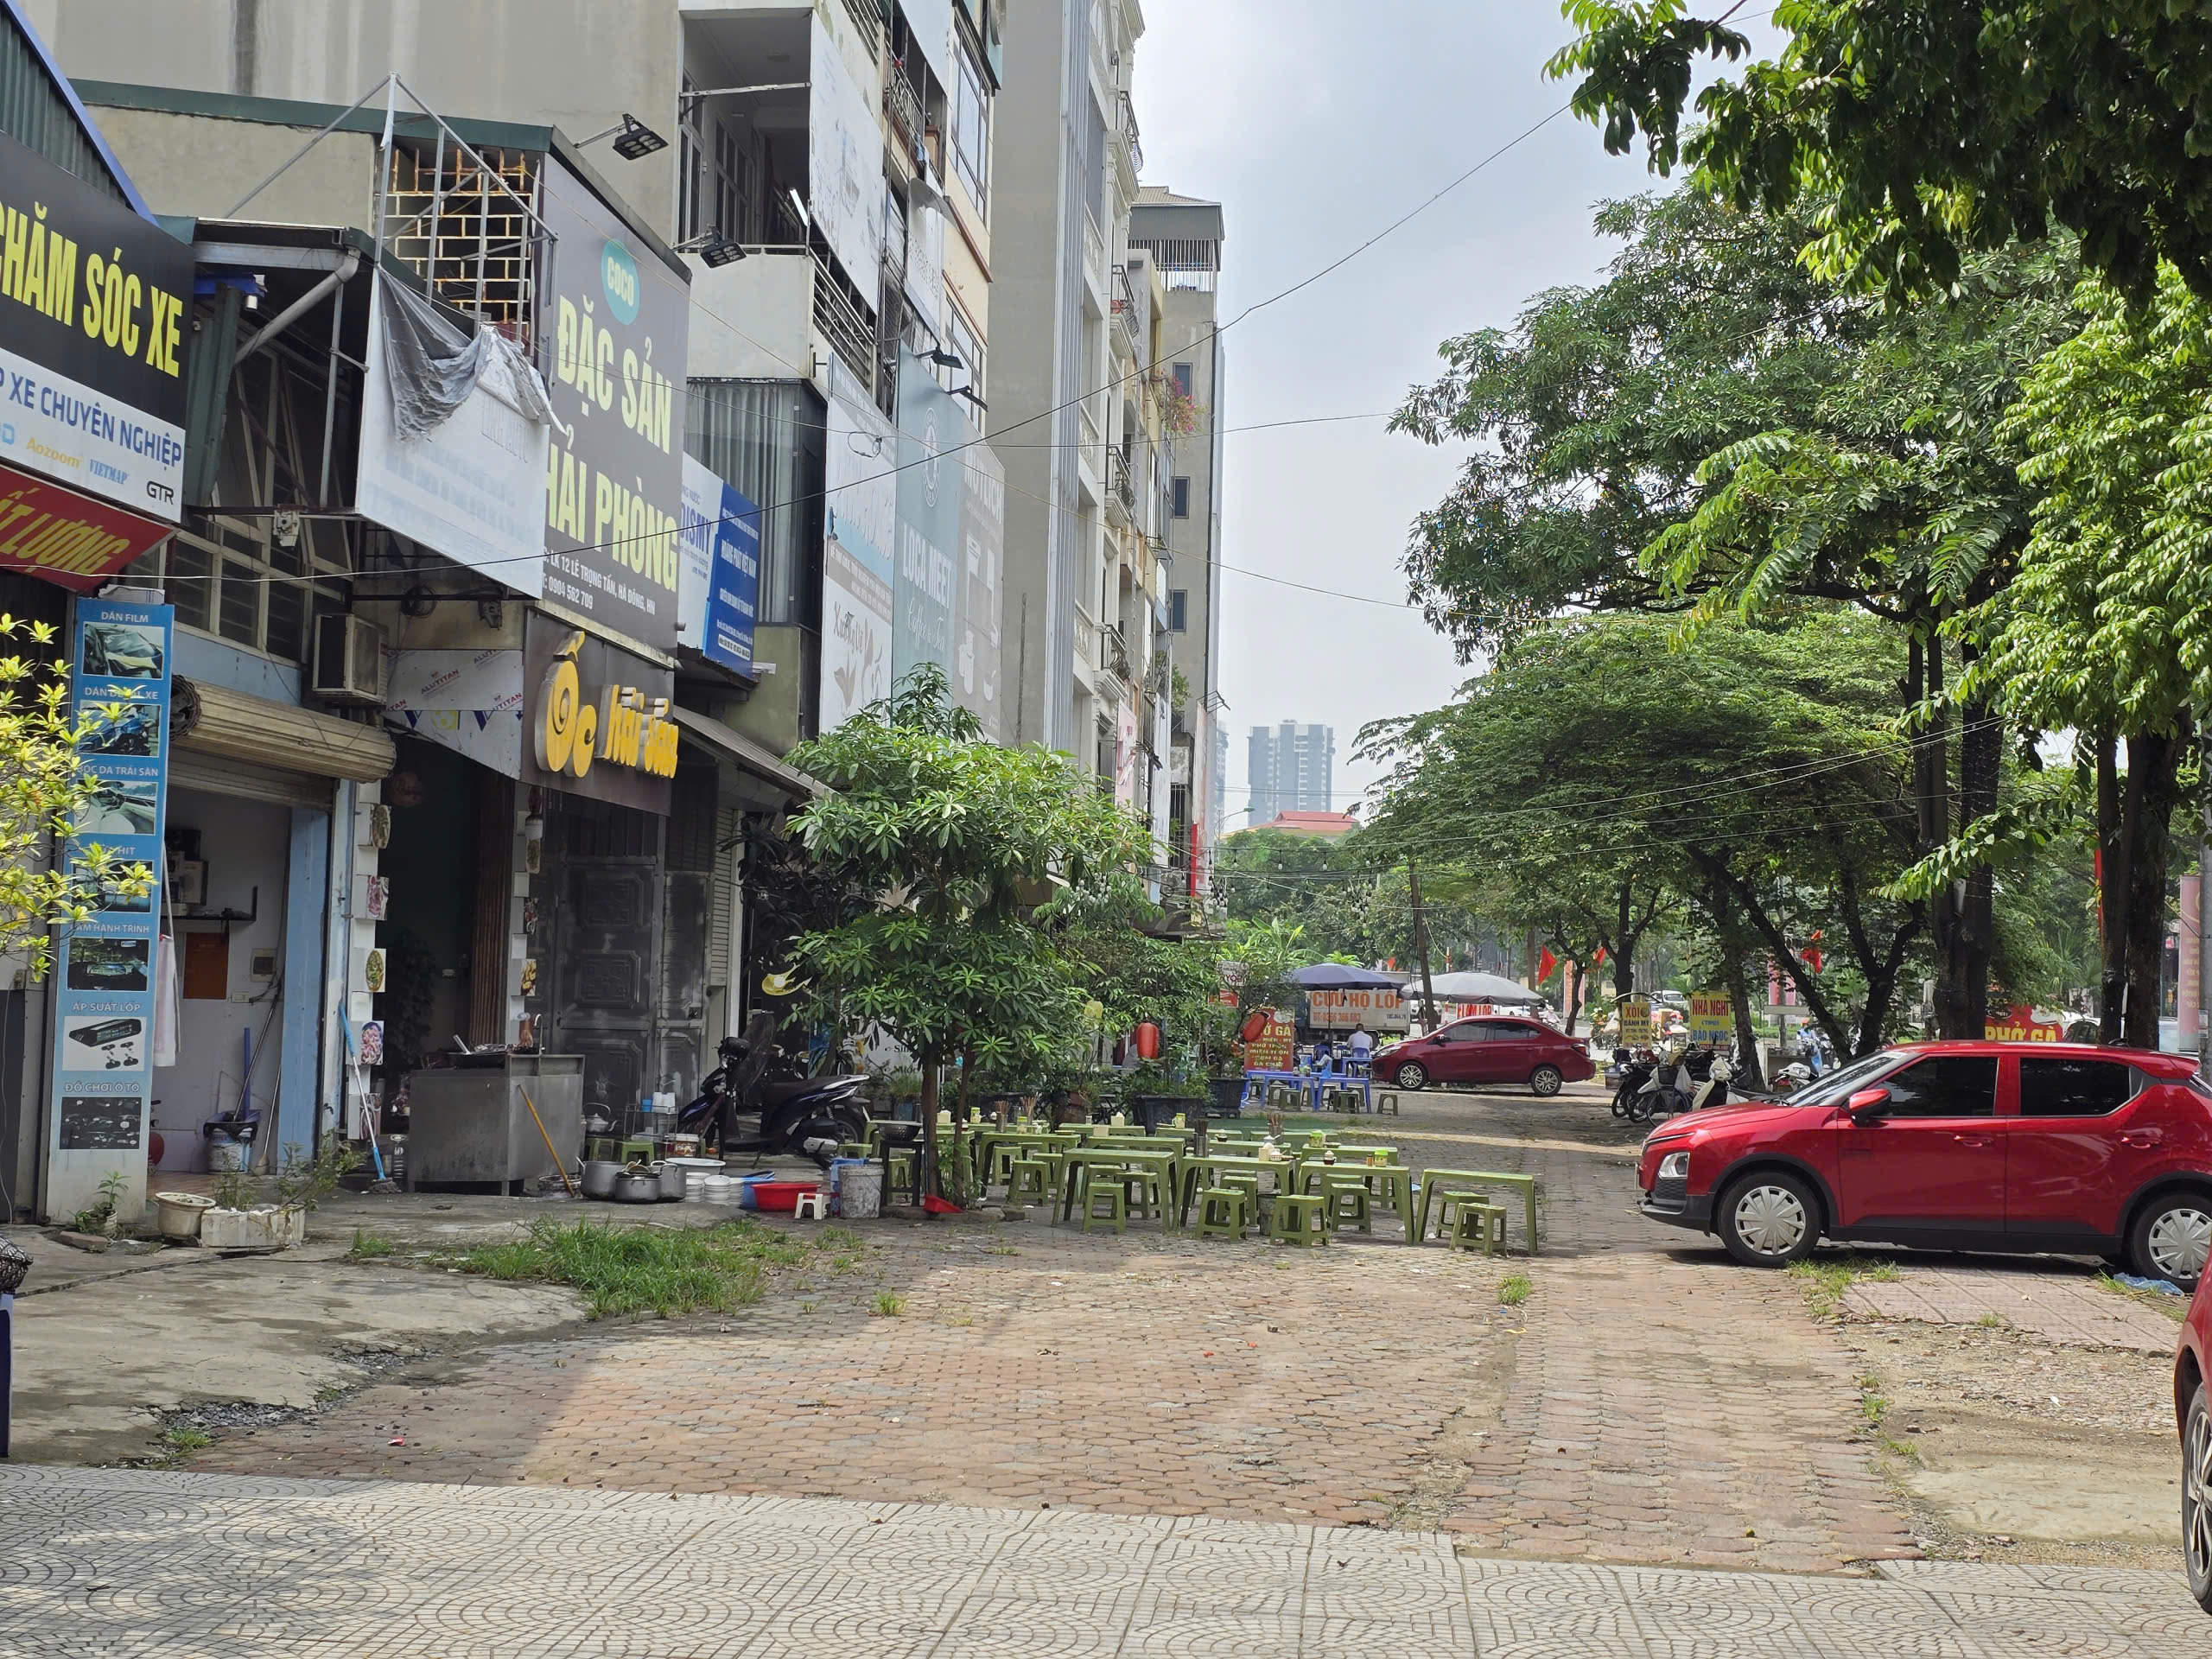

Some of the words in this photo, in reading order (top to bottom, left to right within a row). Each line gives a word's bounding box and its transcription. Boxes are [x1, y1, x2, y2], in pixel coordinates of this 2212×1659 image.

[0, 200, 78, 327] HĂM
[83, 246, 142, 357] SÓC
[145, 285, 183, 378] XE
[557, 294, 614, 417] ĐẶC
[621, 336, 672, 454] SẢN
[9, 371, 36, 410] XE
[41, 385, 115, 443] CHUYÊN
[119, 418, 182, 472] NGHIỆP
[26, 436, 81, 470] Aozoom
[89, 458, 129, 486] VIETMAP
[146, 480, 175, 505] GTR
[0, 512, 130, 574] LƯỢNG
[594, 475, 677, 594] PHÒNG
[902, 520, 927, 593] LOCA
[928, 544, 951, 610] MEET
[548, 575, 566, 598] 0904
[567, 583, 580, 605] 562
[580, 590, 594, 610] 709
[550, 550, 561, 569] LK
[562, 556, 570, 574] 12
[570, 558, 580, 578] LÊ
[580, 564, 602, 588] TRỌNG
[603, 574, 618, 598] TẤN,
[618, 582, 627, 602] HÀ
[627, 588, 646, 612] ĐÔNG,
[646, 598, 656, 615] HN
[101, 609, 124, 622] DÁN
[124, 613, 149, 624] FILM
[84, 686, 107, 696] DÁN
[145, 690, 160, 701] XE
[421, 668, 461, 696] ALUTITAN
[492, 691, 523, 711] UTITAN
[537, 631, 598, 779] Ốc
[99, 766, 114, 776] DA
[1984, 1020, 2027, 1042] PHỞ
[85, 1082, 113, 1093] CHƠI
[114, 1081, 124, 1093] Ô
[124, 1081, 141, 1093] TÔ
